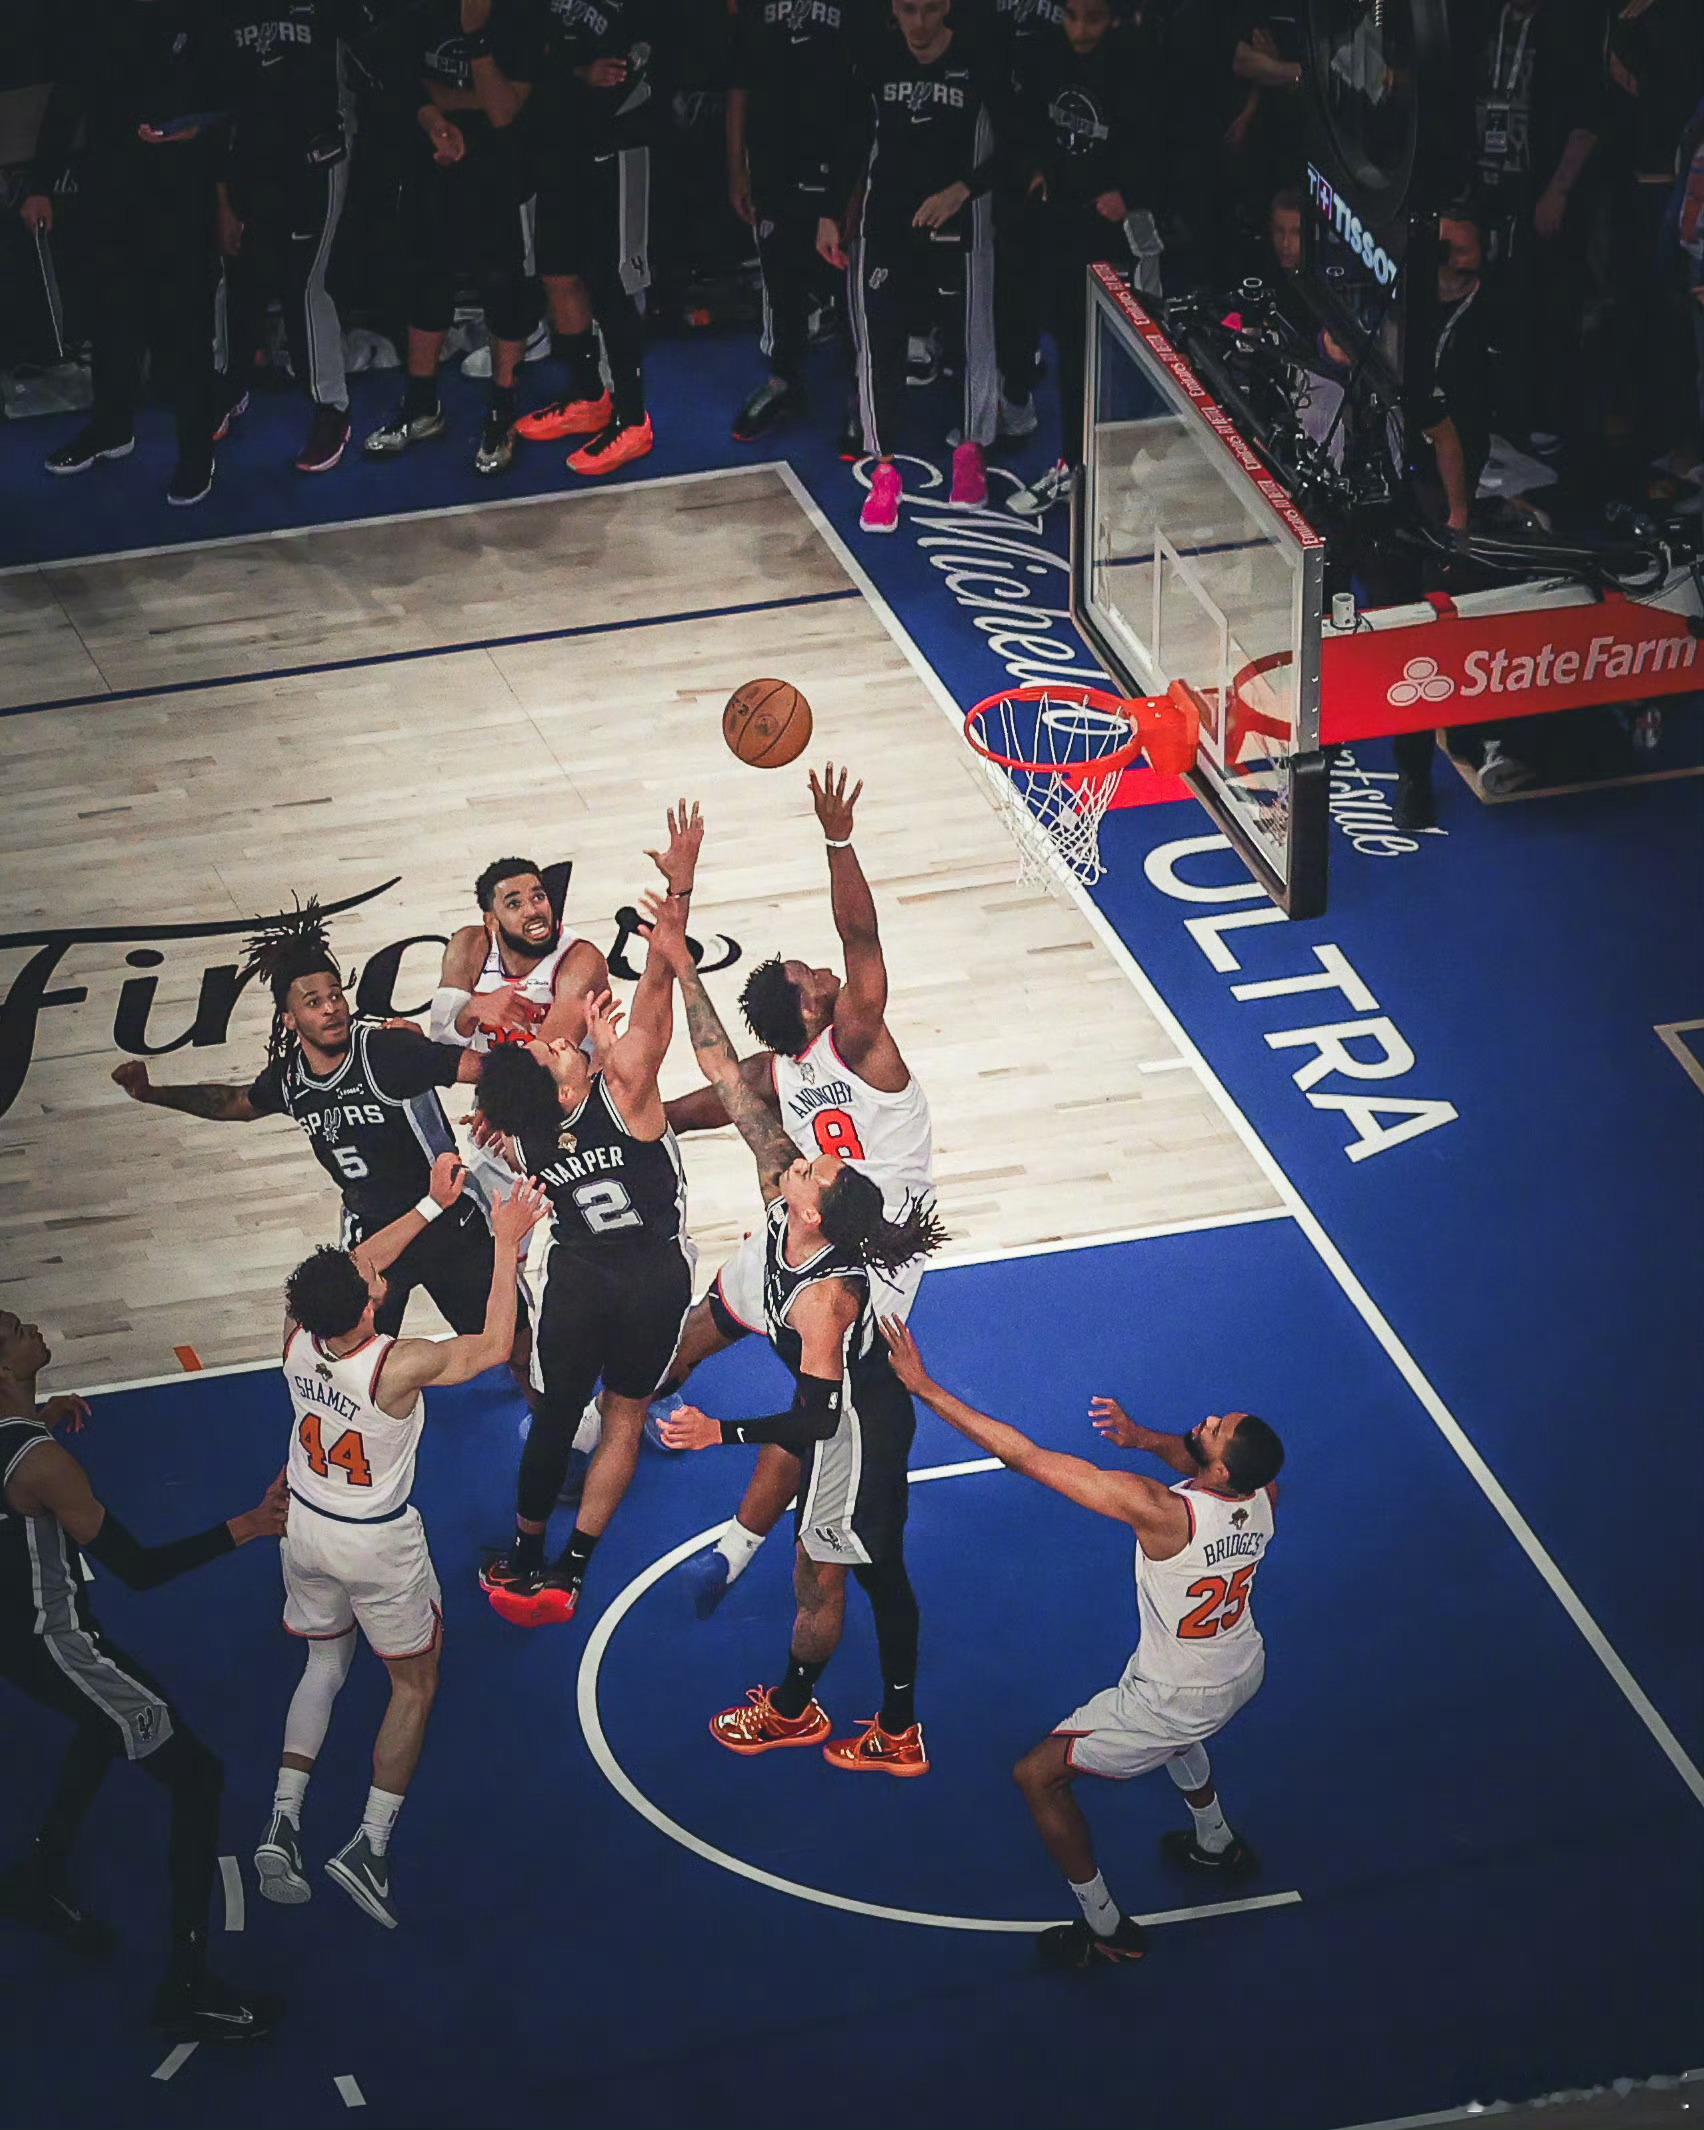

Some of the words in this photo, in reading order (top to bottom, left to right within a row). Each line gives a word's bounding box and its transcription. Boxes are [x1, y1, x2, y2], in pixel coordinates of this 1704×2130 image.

[884, 81, 964, 112] SPURS
[1144, 834, 1460, 1164] ULTRA
[788, 1081, 854, 1119] ANUNOBY
[297, 1104, 385, 1143] SPURS
[812, 1107, 866, 1161] 8
[332, 1146, 370, 1180] 5
[540, 1146, 625, 1187] HARPER
[572, 1179, 644, 1234] 2
[295, 1376, 361, 1422] SHAMET
[298, 1411, 373, 1487] 44
[1203, 1532, 1264, 1567] BRIDGES
[1176, 1559, 1259, 1639] 25
